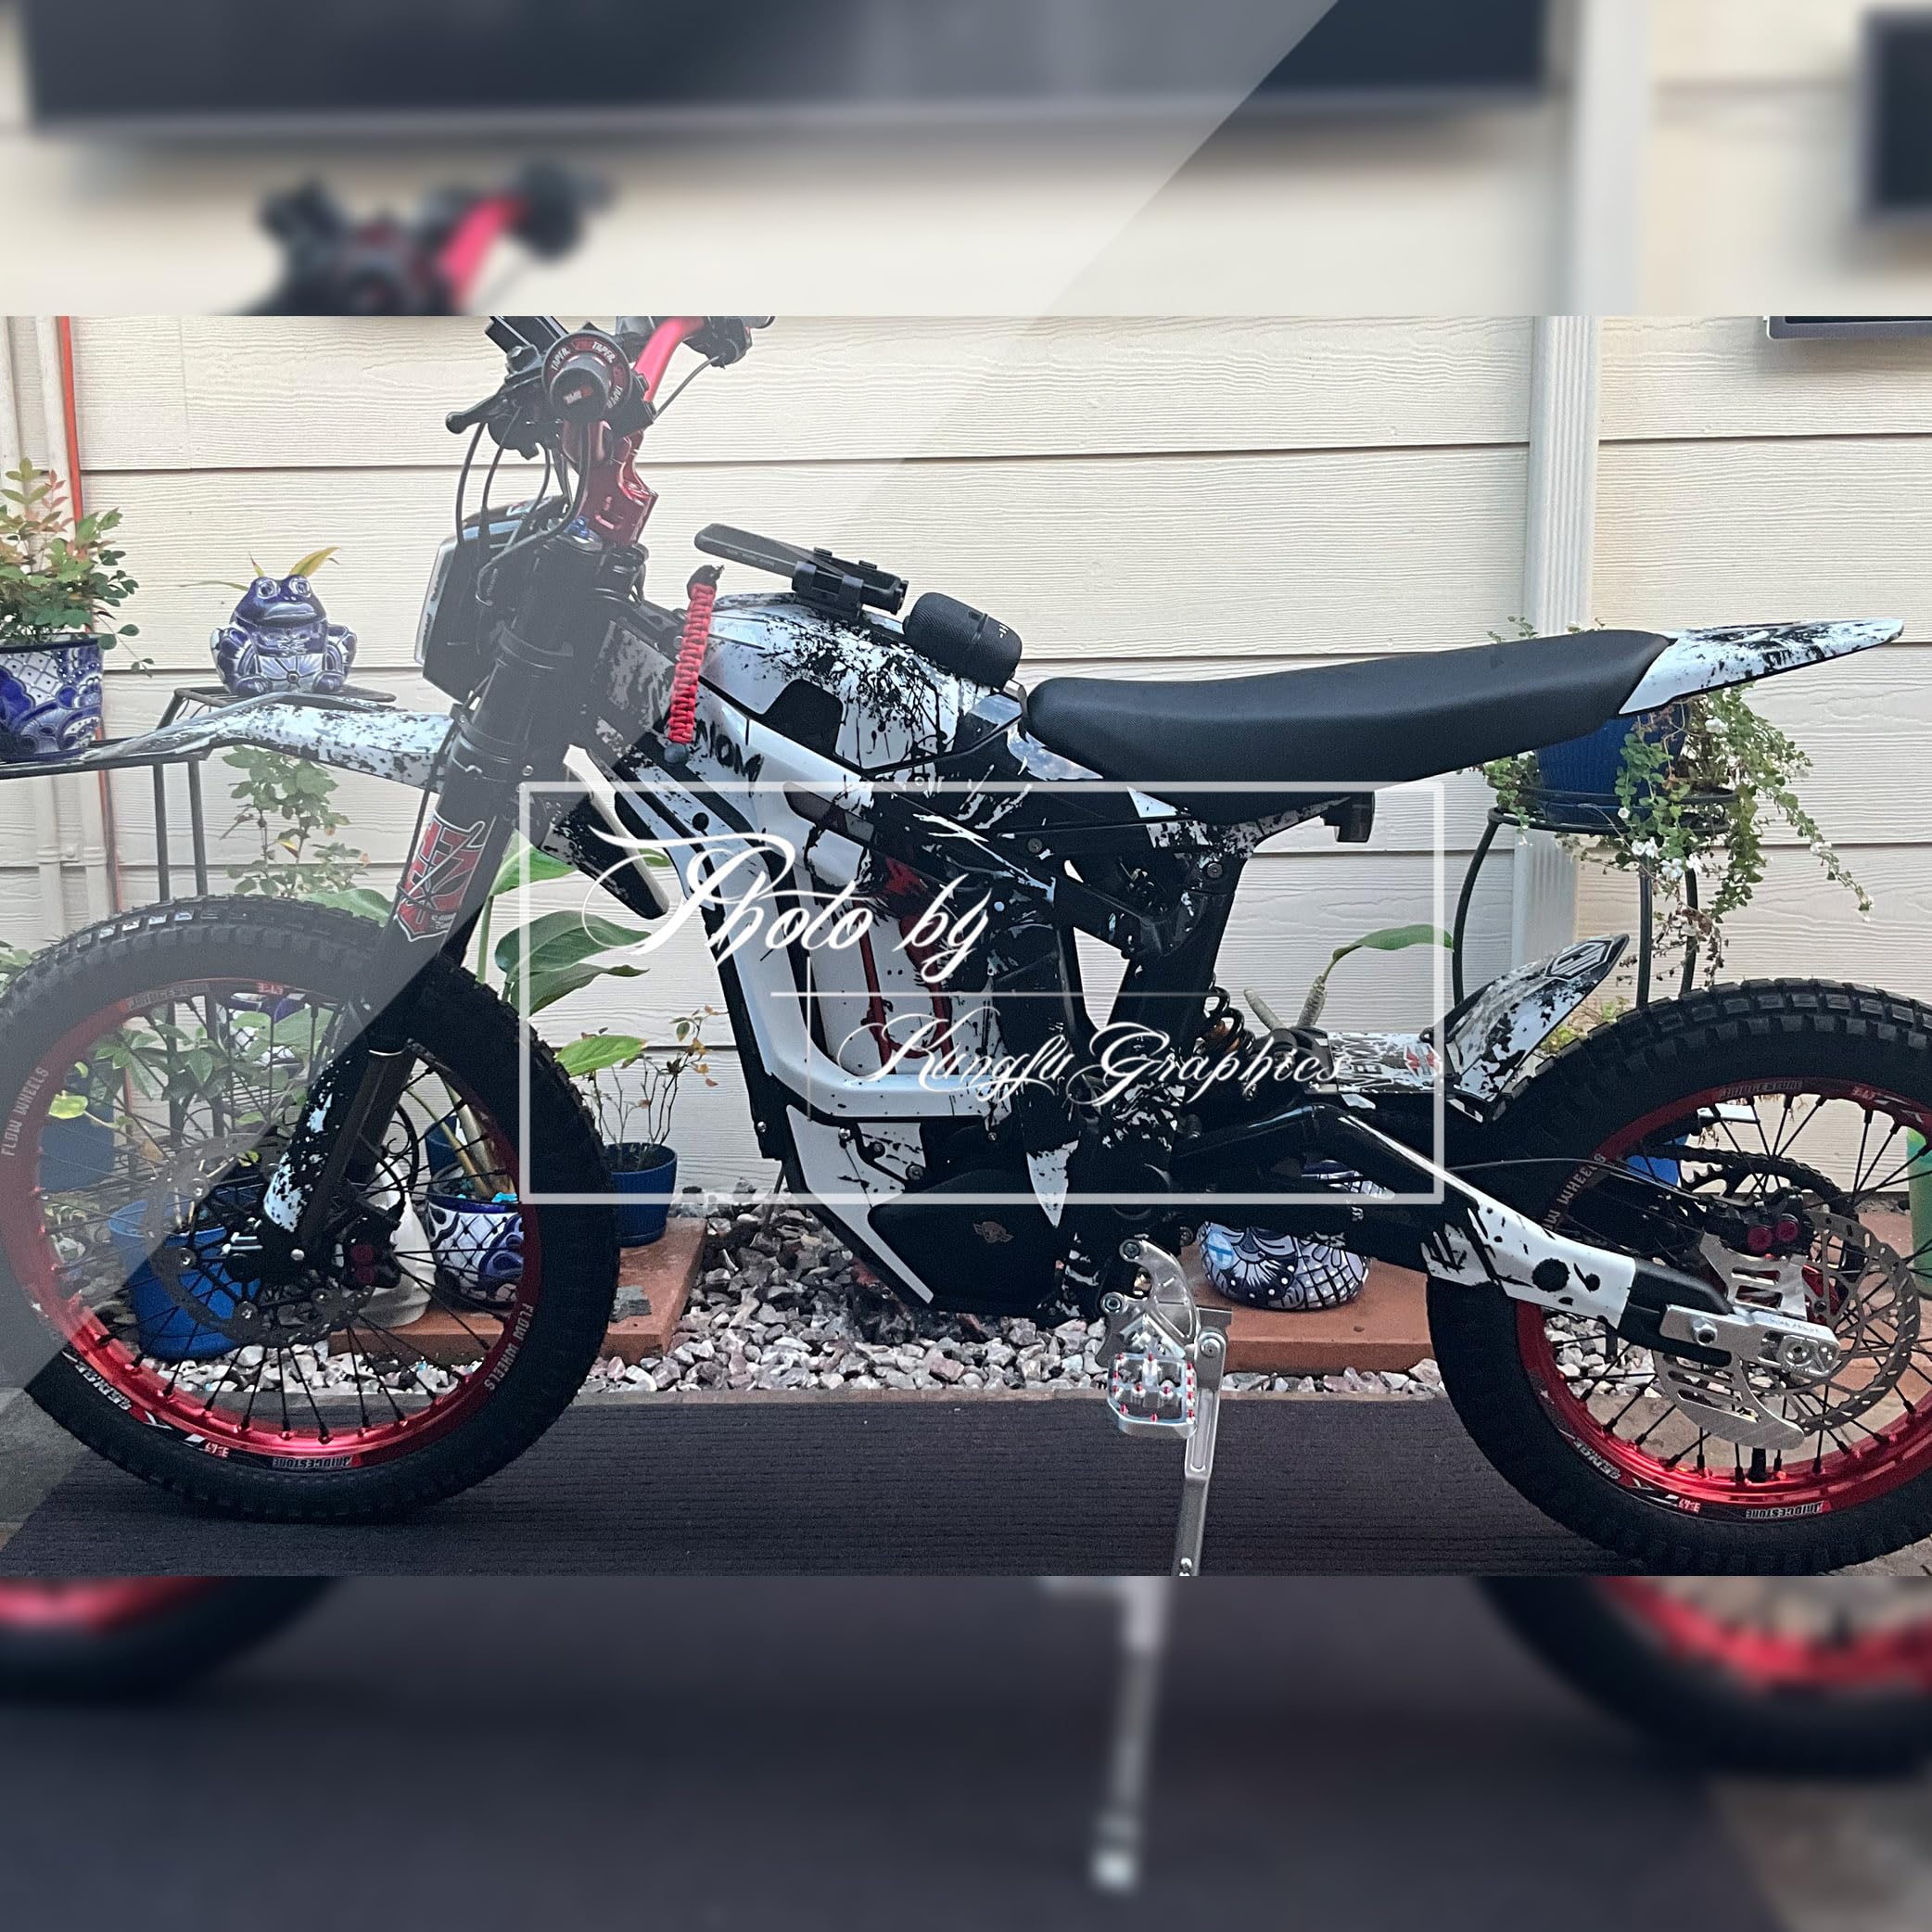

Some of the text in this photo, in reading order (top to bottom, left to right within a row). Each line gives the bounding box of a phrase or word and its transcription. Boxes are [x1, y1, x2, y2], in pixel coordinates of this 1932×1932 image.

[1, 1067, 49, 1156] FLOW WHEELS
[484, 1303, 534, 1391] FLOW WHEELS
[272, 1455, 352, 1469] BRIDGESTONE
[1746, 1500, 1824, 1519] BRIDGESTONE
